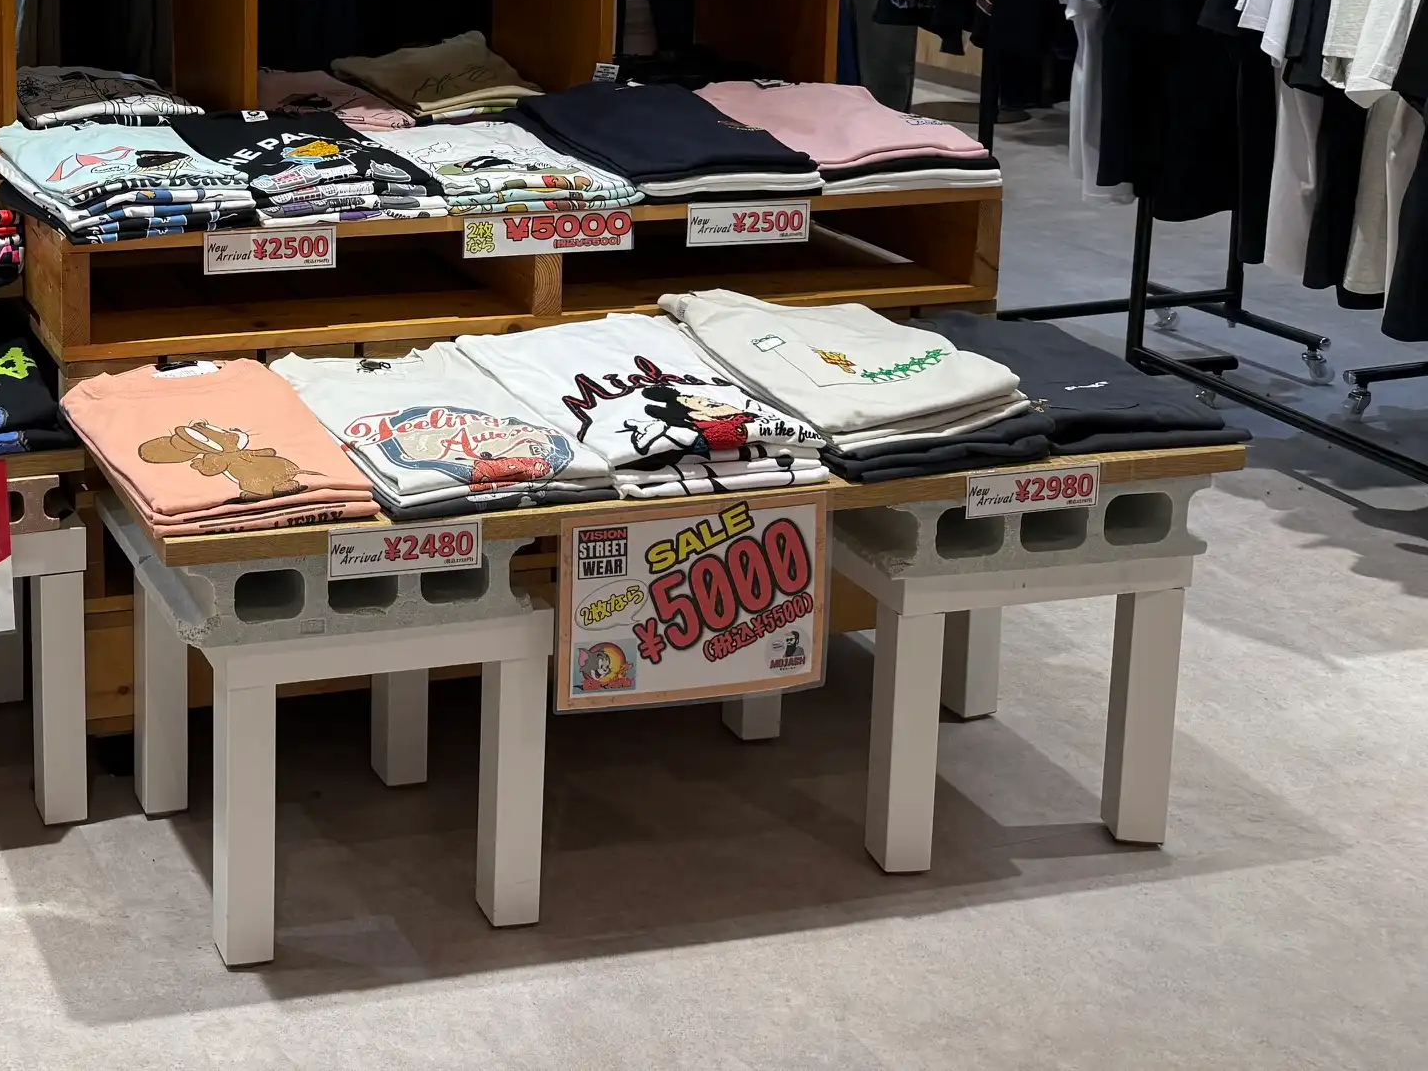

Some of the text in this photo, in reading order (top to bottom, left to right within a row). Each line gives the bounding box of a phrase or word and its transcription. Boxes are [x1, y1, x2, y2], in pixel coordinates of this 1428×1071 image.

[503, 211, 632, 241] ¥5000
[691, 216, 710, 226] New
[698, 224, 732, 234] Arrival
[732, 210, 803, 233] ¥2500
[208, 243, 228, 254] New
[253, 235, 329, 260] ¥2500
[466, 237, 495, 253] なら
[216, 250, 252, 261] Arrival
[344, 409, 502, 447] Feeling
[759, 424, 772, 437] in
[774, 422, 795, 437] the
[969, 486, 990, 497] New
[1015, 473, 1093, 502] ¥2980
[977, 492, 1014, 506] Arrival
[579, 529, 627, 540] VISION
[645, 500, 754, 575] SALE
[332, 544, 356, 557] New
[384, 530, 473, 562] ¥2480
[579, 540, 627, 558] STREET
[340, 550, 383, 565] Arrival
[583, 559, 623, 576] WEAR
[633, 518, 811, 664] ¥5000
[580, 585, 644, 626] 2枚なら
